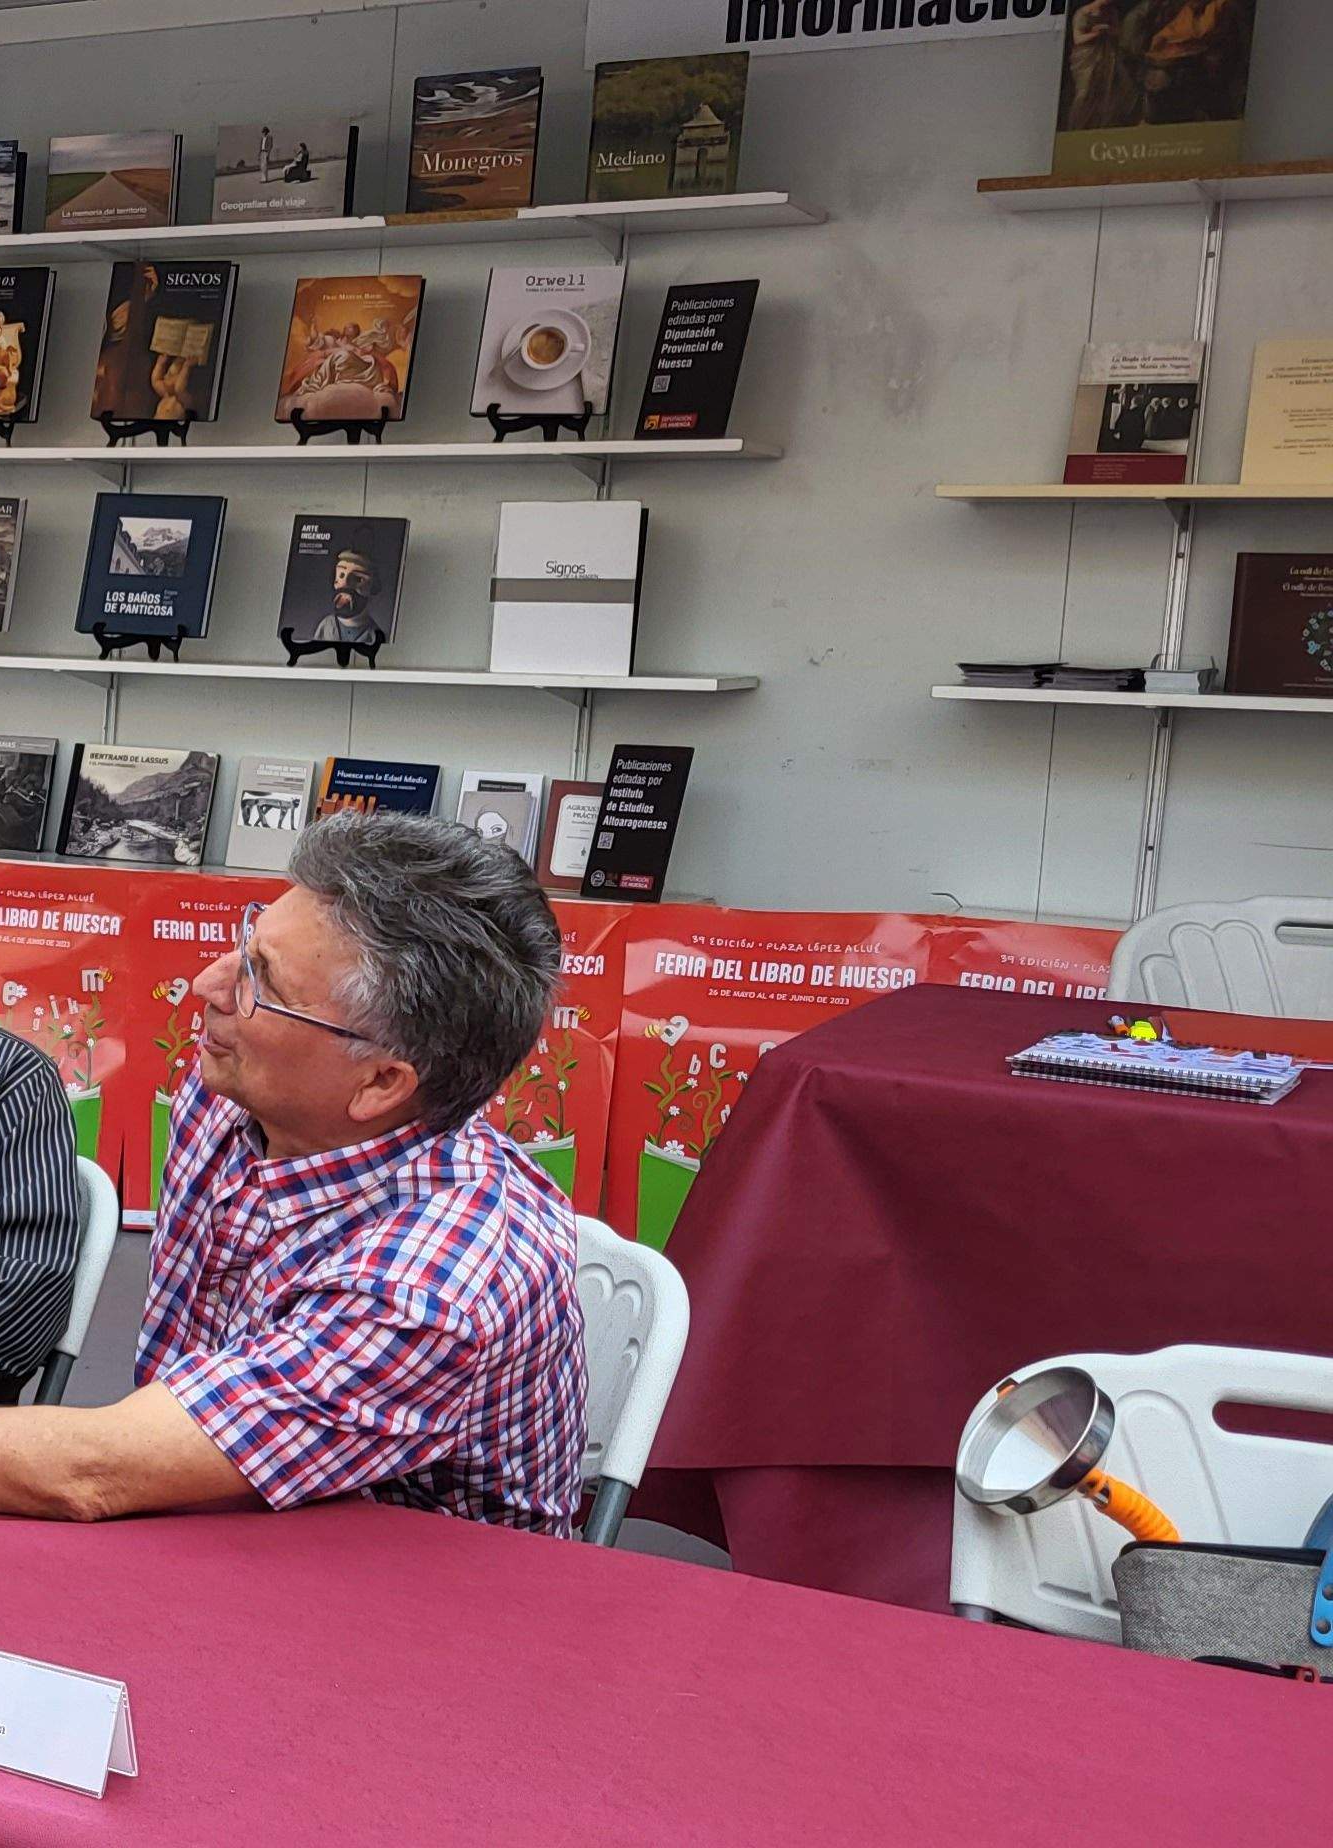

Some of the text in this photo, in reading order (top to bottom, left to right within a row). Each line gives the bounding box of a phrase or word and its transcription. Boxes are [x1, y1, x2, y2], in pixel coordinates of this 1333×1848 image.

[597, 150, 666, 167] Mediano
[1091, 142, 1146, 163] Goya
[421, 153, 523, 176] Monegros
[166, 273, 221, 286] SIGNOS
[526, 274, 586, 286] Orwell
[671, 298, 735, 311] Publicaciones
[668, 314, 725, 326] editadas por
[664, 327, 716, 342] Diputación
[661, 341, 724, 354] Provincial de
[657, 358, 693, 369] Huesca
[301, 524, 319, 532] ARTE
[300, 532, 331, 540] INGENUO
[546, 560, 586, 577] Signos
[106, 591, 126, 603] LOS
[128, 591, 161, 604] BAÑOS
[104, 603, 173, 616] DE PANTICOSA
[90, 752, 128, 762] BERTRAND
[141, 756, 169, 764] LASSUS
[616, 759, 672, 772] Publicaciones
[337, 770, 364, 779] Huesca
[375, 773, 383, 781] la
[384, 773, 403, 782] Edad
[404, 774, 427, 785] Media
[613, 773, 662, 787] editadas por
[609, 787, 644, 799] Instituto
[606, 801, 655, 814] de Estudios
[602, 815, 668, 830] Altoaragoneses
[7, 890, 35, 899] PLAZA
[38, 890, 65, 901] LÓPEZ
[67, 893, 95, 903] ALLUÉ
[193, 902, 231, 911] EDICIÓN
[41, 911, 60, 931] DE
[63, 911, 121, 936] HUESCA
[153, 919, 195, 941] FERIA
[199, 922, 226, 943] DEL
[709, 936, 755, 949] EDICIÓN
[766, 941, 804, 952] PLAZA
[807, 942, 842, 953] LÓPEZ
[844, 942, 882, 954] ALLUÉ
[560, 955, 605, 976] ESCA
[1019, 955, 1069, 970] EDICIÓN
[654, 952, 916, 990] FERIA DEL LIBRO DE HUESCA
[960, 971, 1016, 992] FERIA
[1022, 979, 1055, 997] DEL
[708, 988, 849, 1005] 26 DE MAYO AL 4 DE JUNIO DE 2023
